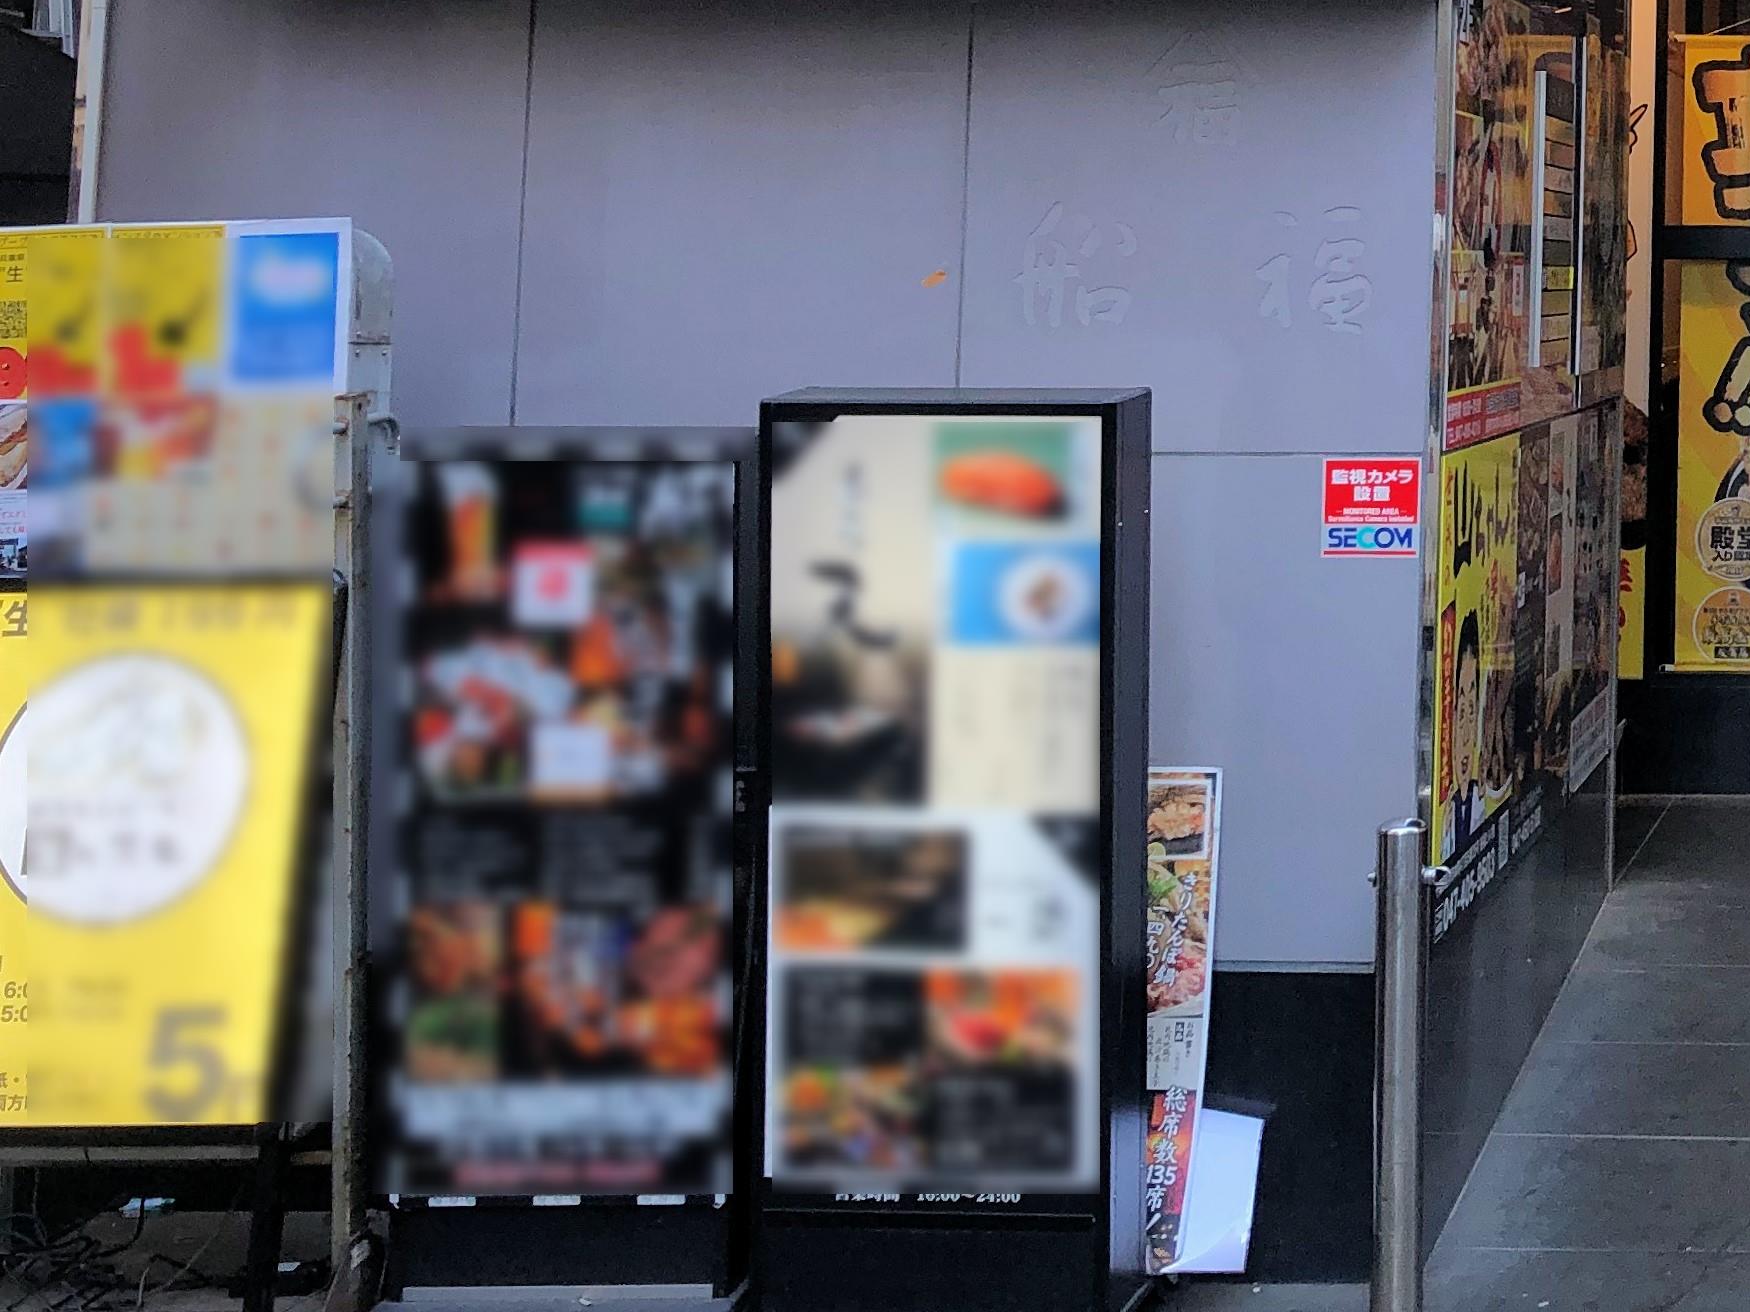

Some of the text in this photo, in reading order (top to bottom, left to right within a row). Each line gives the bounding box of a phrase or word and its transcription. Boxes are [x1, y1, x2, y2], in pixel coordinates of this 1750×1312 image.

[1331, 469, 1414, 485] 監視カメラ
[1328, 526, 1412, 549] SECOM
